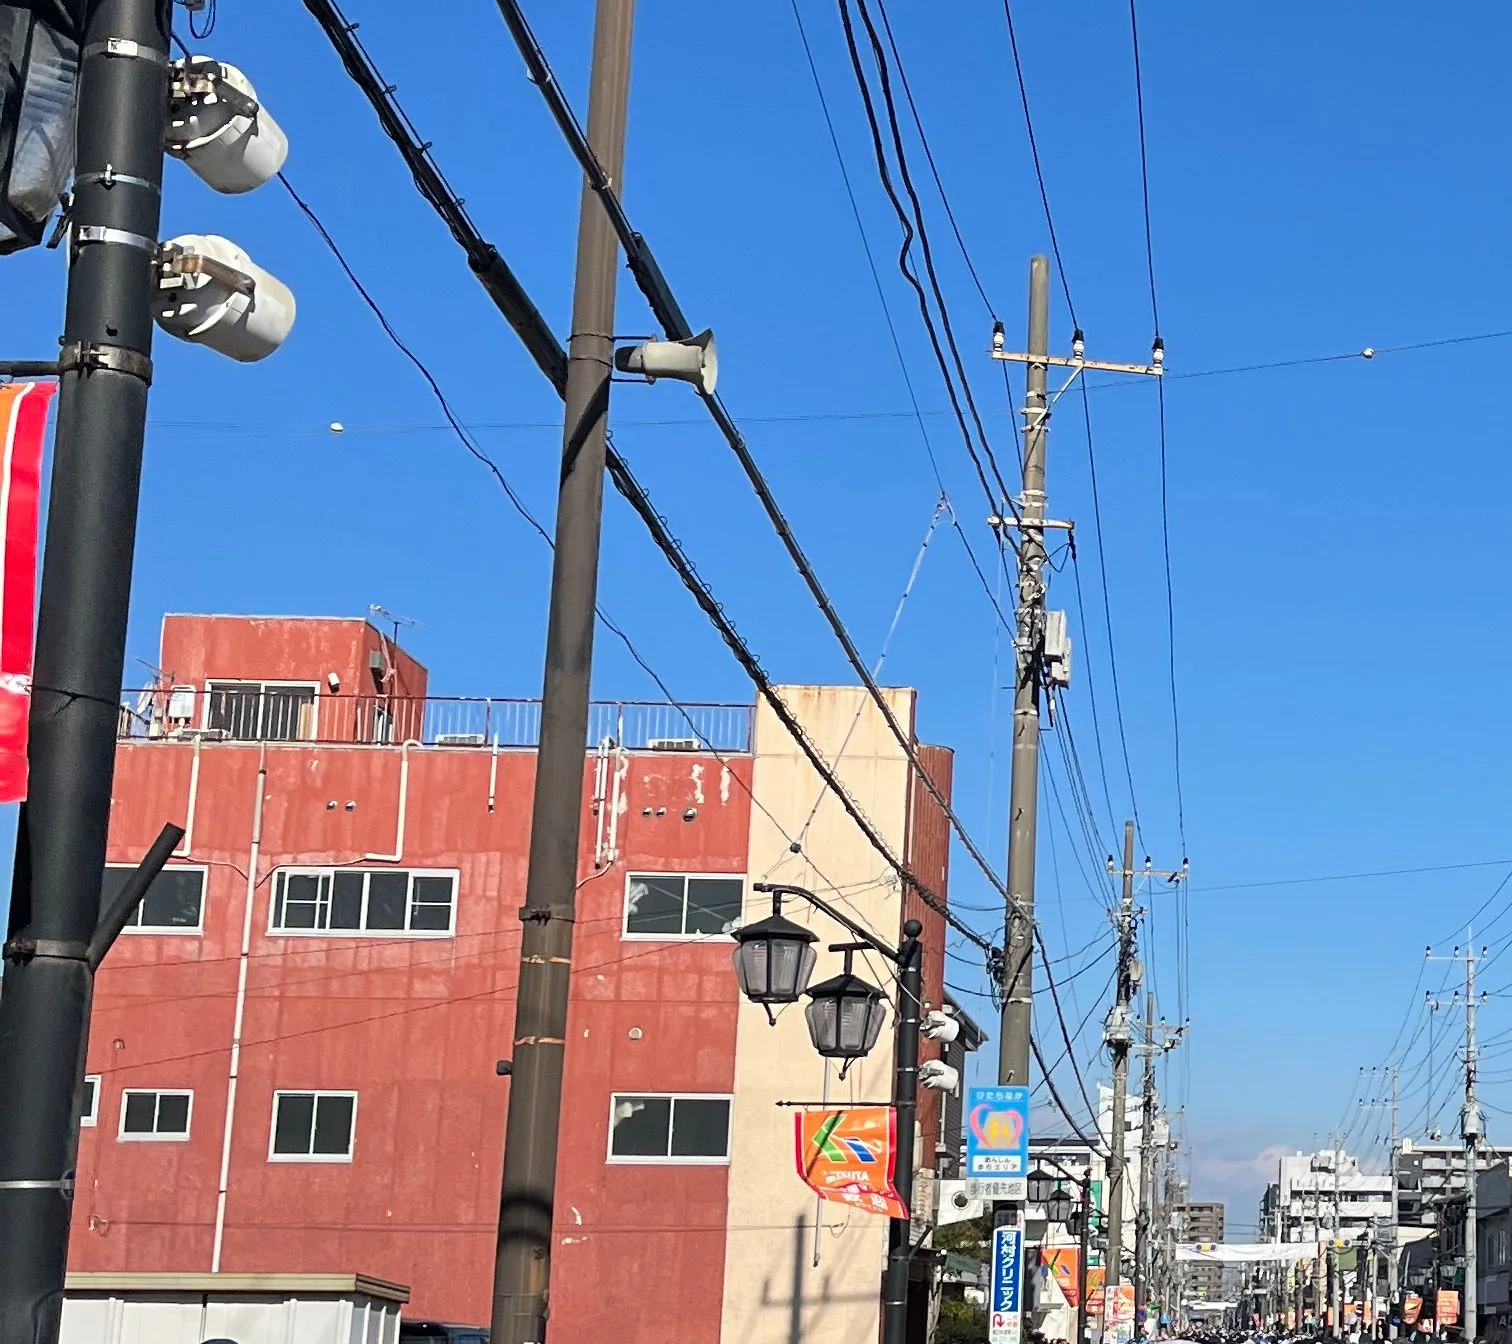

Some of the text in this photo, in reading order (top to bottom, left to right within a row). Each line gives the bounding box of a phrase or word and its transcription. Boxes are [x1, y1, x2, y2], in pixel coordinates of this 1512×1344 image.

[1000, 1231, 1017, 1312] 河村クリニック
